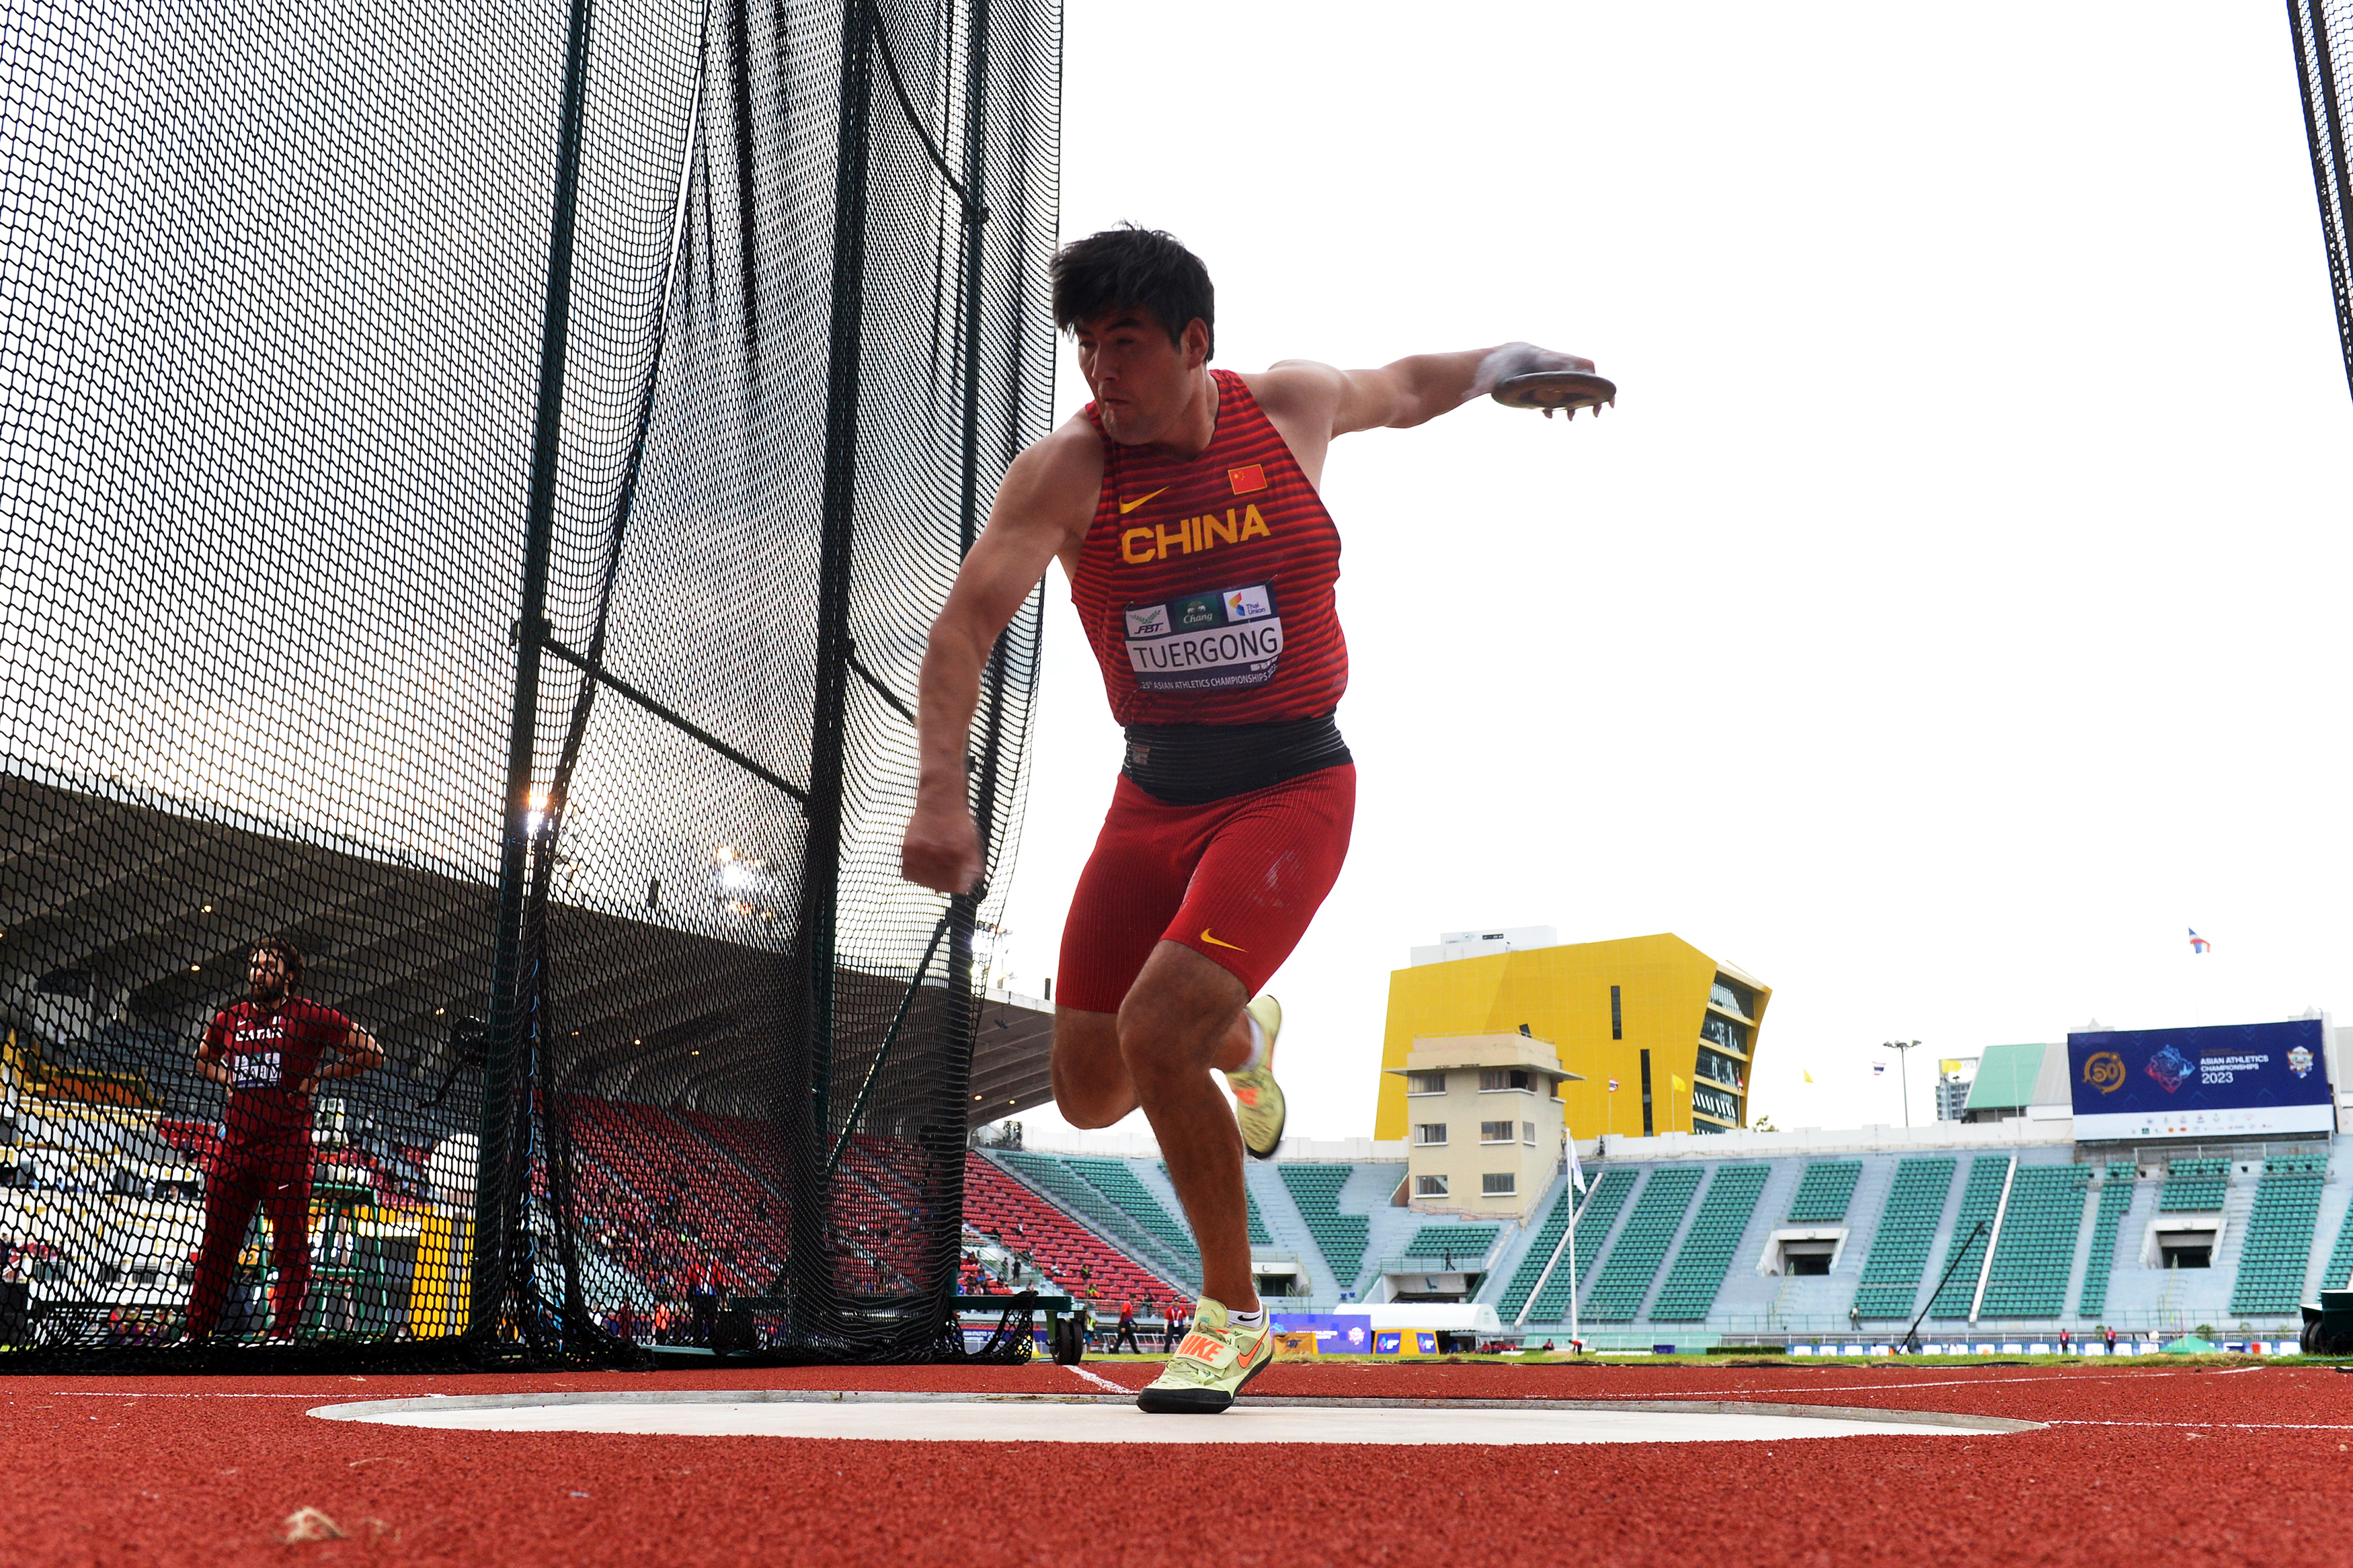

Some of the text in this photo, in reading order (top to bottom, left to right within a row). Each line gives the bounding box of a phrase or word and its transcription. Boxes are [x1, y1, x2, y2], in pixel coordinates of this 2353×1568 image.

[1121, 503, 1271, 565] CHINA
[1183, 612, 1213, 624] Chang
[1134, 622, 1164, 634] FBT
[1133, 627, 1278, 669] TUERGONG
[1154, 682, 1174, 690] ASIAN
[1176, 679, 1210, 690] ATHLETICS
[1211, 672, 1268, 687] CHAMPIONSHIPS
[2200, 1055, 2269, 1065] ASIAN ATHLETICS
[2200, 1063, 2260, 1073] CHAMPIONSHIPS
[2202, 1071, 2234, 1084] 2023
[1174, 1334, 1224, 1362] NIKE
